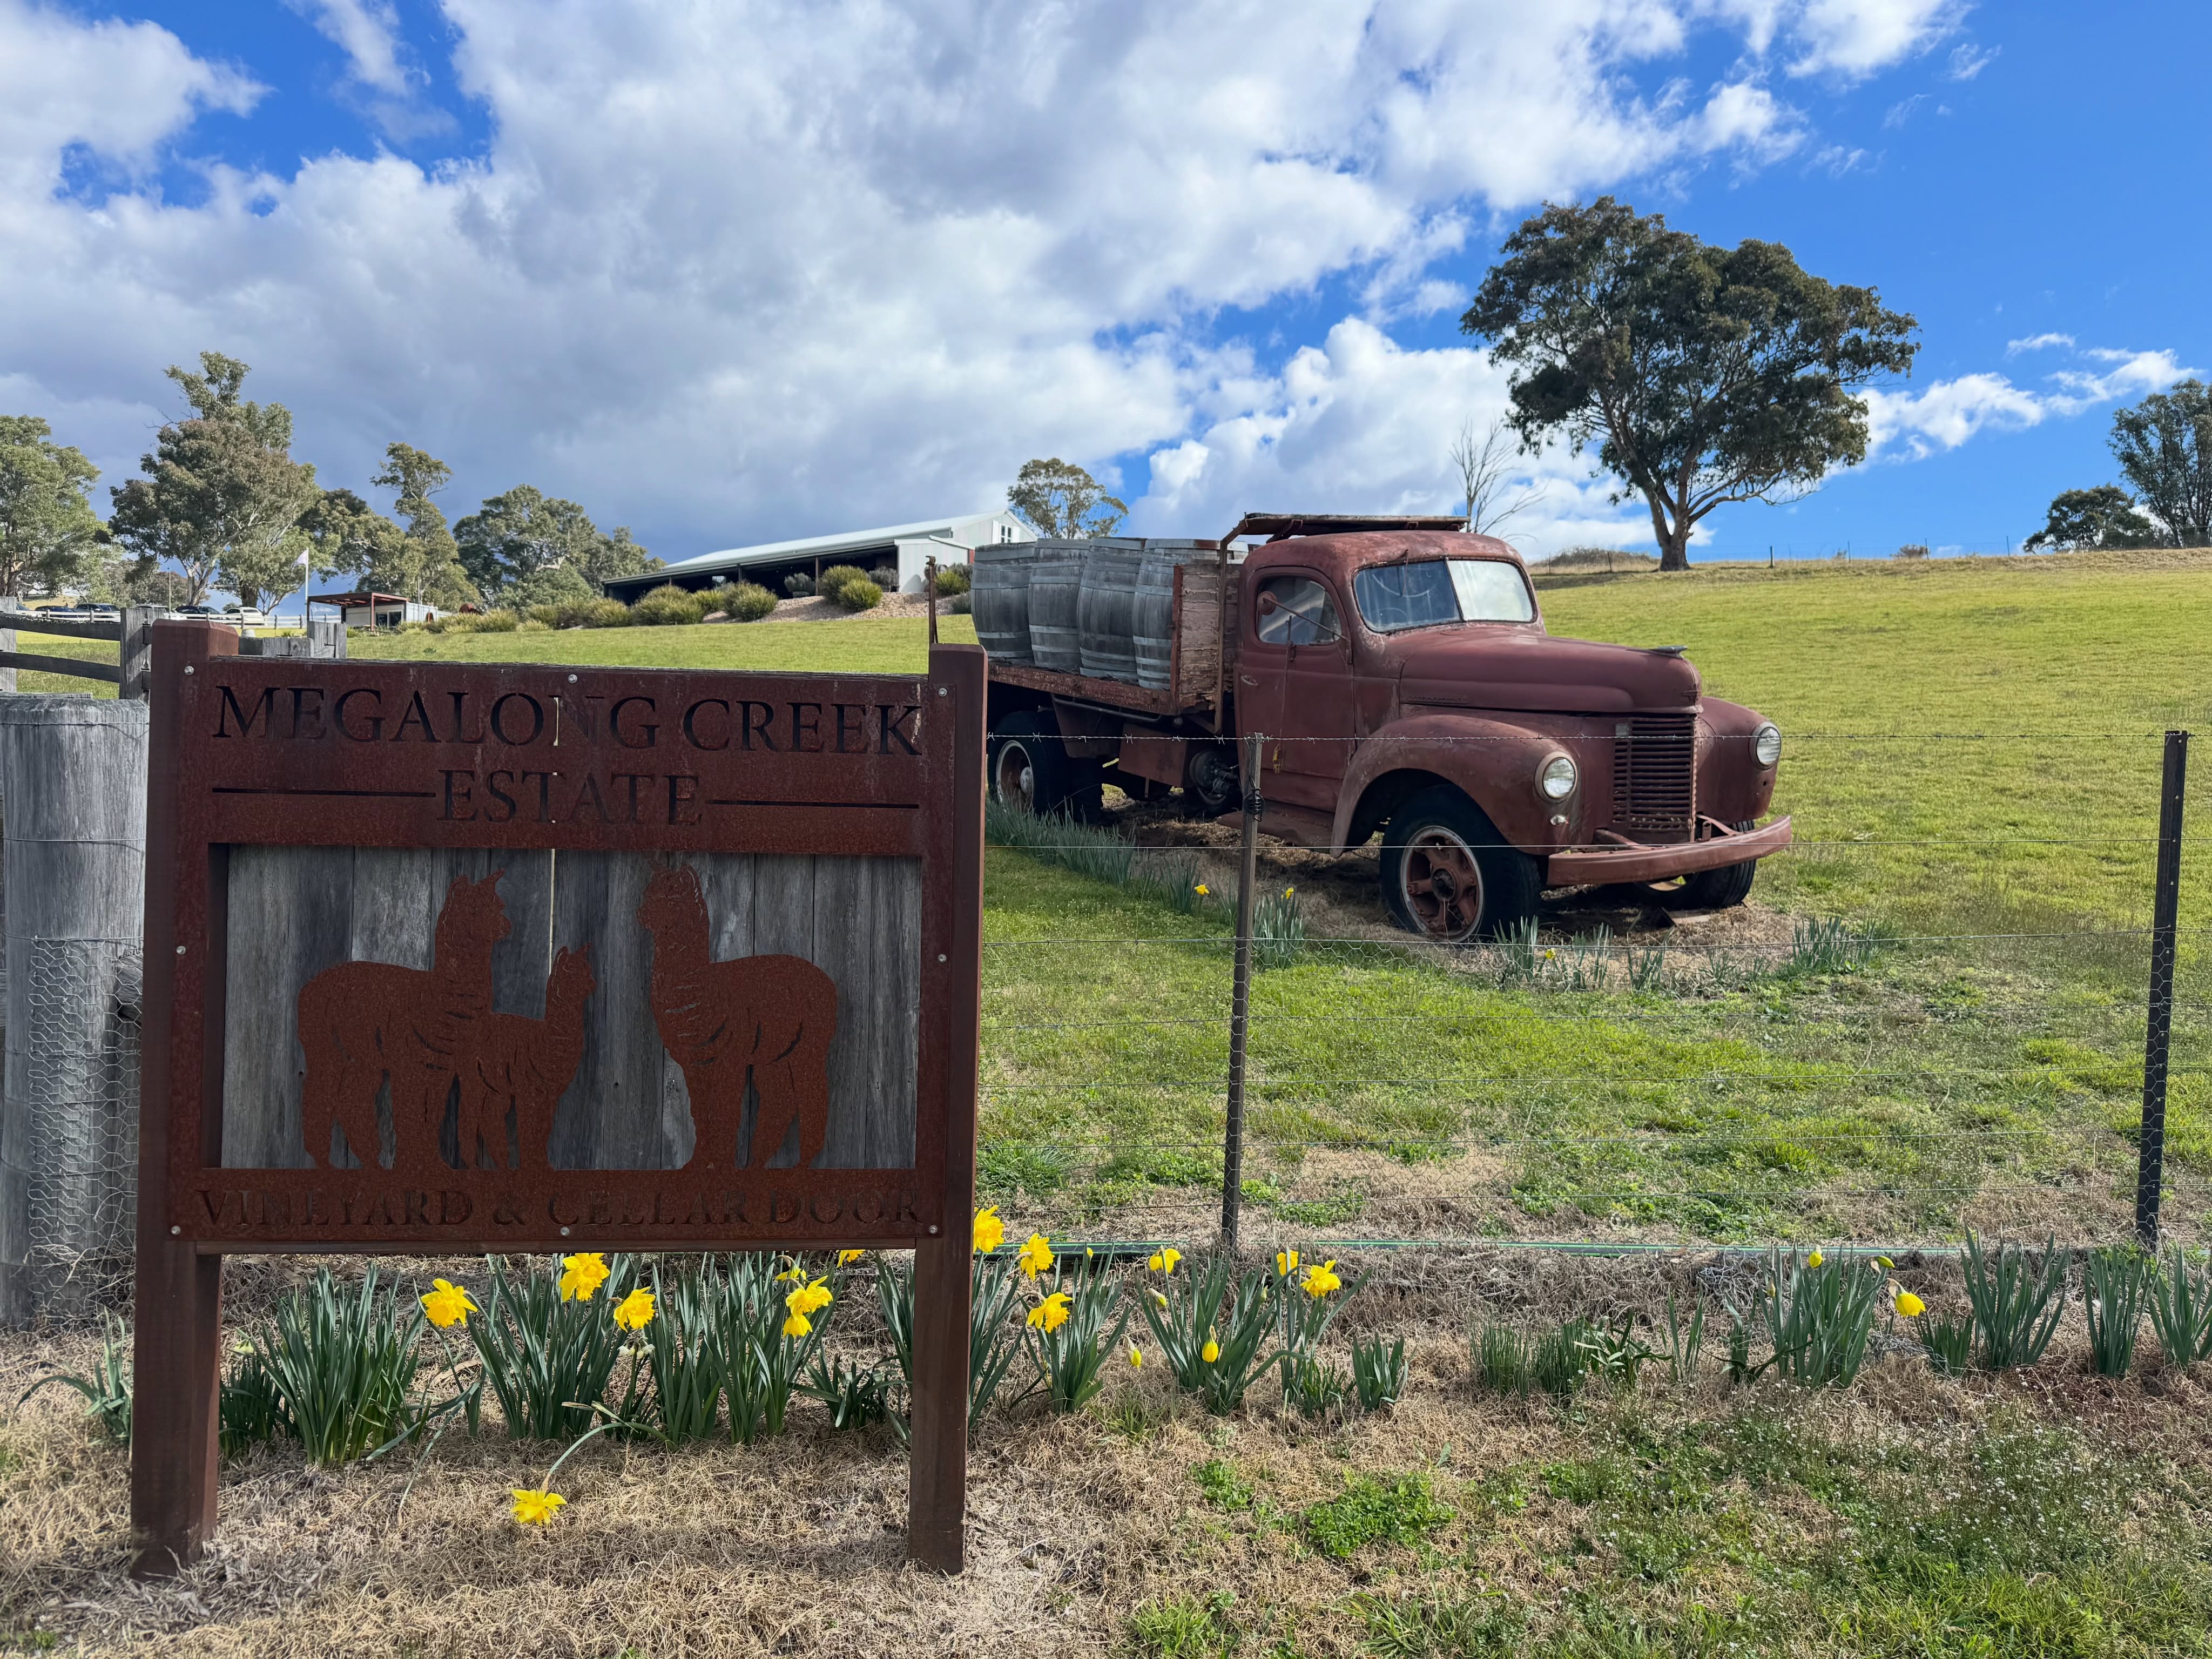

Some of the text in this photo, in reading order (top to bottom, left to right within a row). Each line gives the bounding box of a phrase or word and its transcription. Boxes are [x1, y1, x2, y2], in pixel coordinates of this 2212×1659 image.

[212, 685, 923, 756] MEGALONG CREEK
[436, 769, 703, 826] ESTATE
[195, 1189, 923, 1226] VINEYARD & CELLAR DOOR
